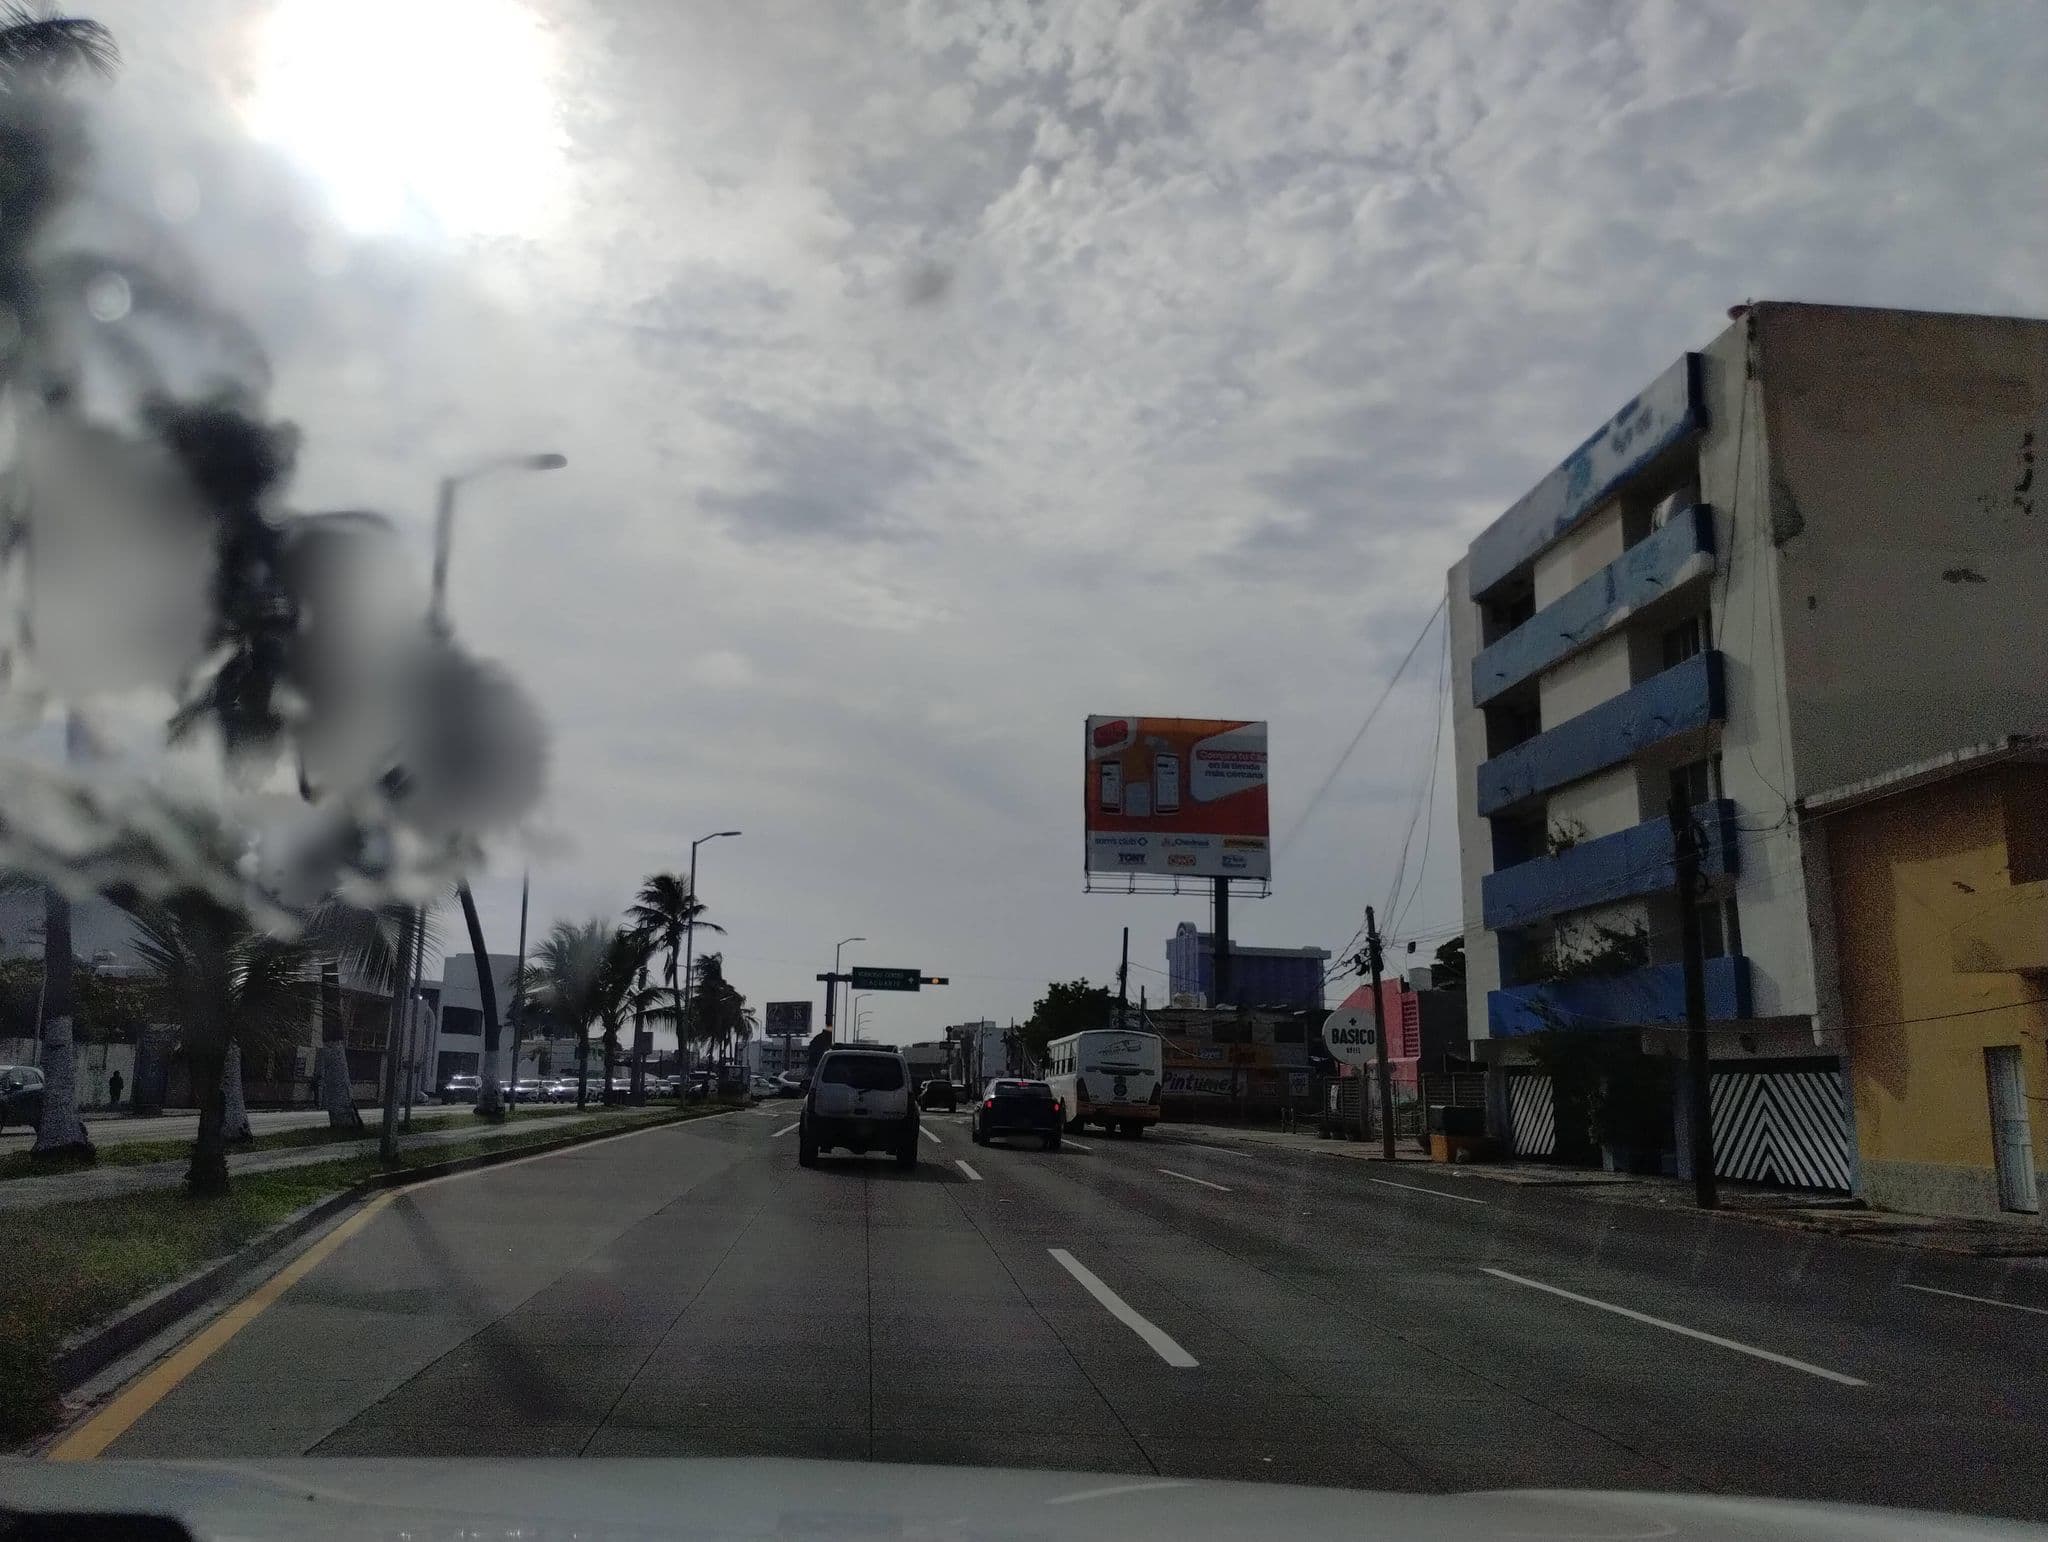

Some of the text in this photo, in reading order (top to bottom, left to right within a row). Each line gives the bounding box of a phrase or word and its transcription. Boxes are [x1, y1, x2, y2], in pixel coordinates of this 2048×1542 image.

[1231, 762, 1260, 771] tienda
[1226, 770, 1264, 779] cercana
[1331, 1028, 1375, 1045] BASICO
